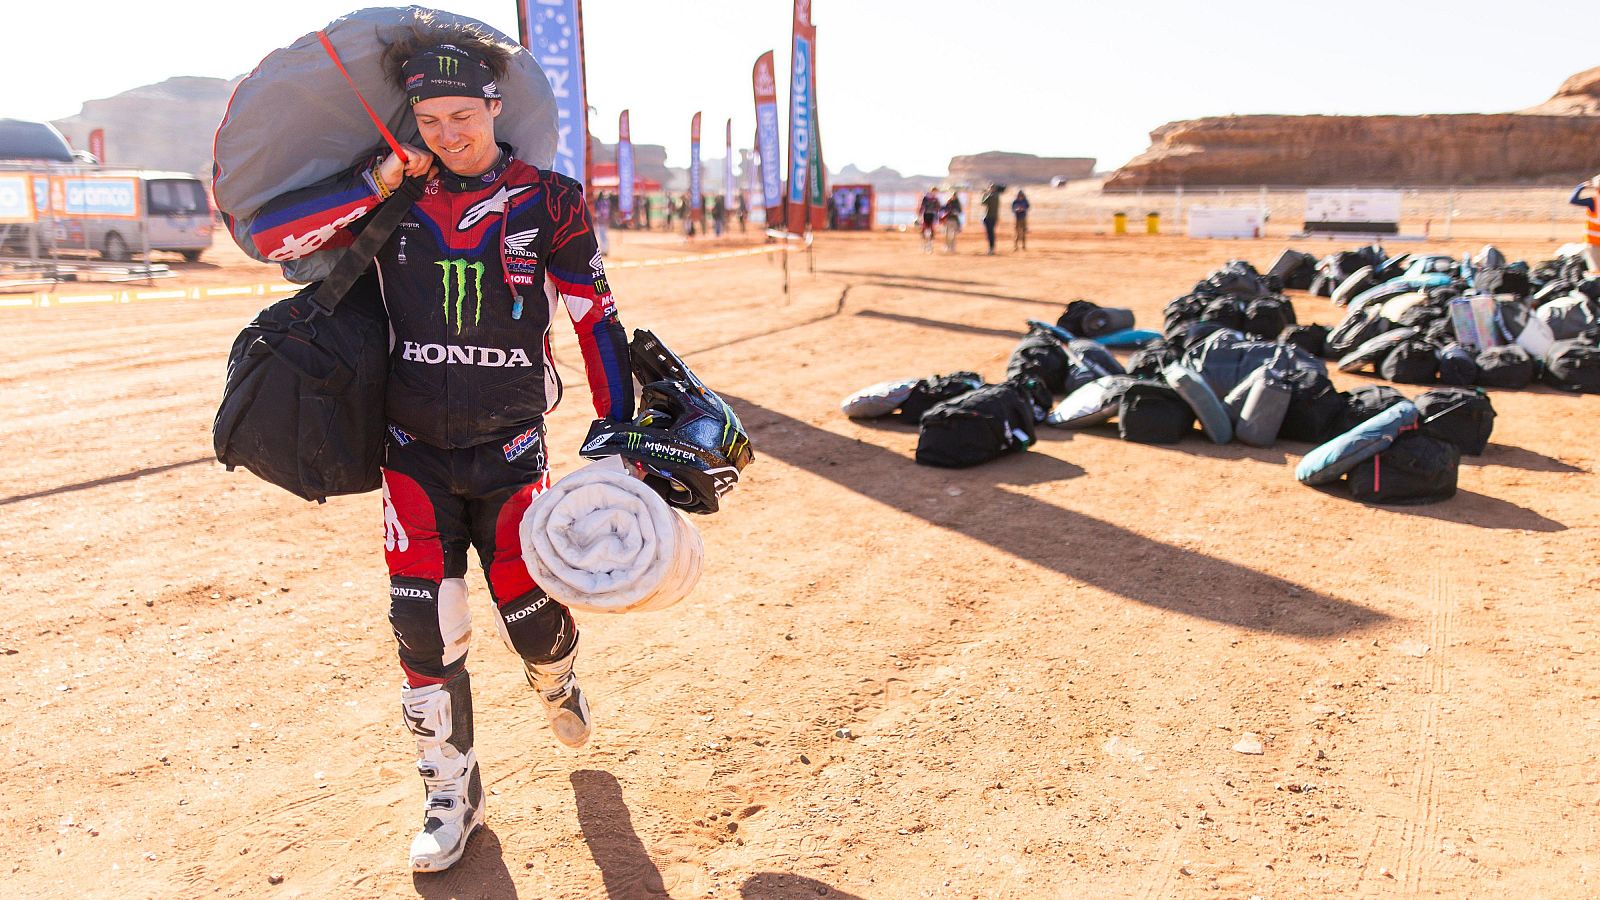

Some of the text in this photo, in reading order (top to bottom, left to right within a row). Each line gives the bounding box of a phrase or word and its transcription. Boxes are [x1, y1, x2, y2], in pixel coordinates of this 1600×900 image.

[793, 51, 809, 191] aramco
[504, 248, 538, 259] HONDA
[402, 340, 533, 369] HONDA
[503, 426, 539, 461] HRC
[586, 435, 605, 450] AIROH
[644, 441, 696, 462] MONSTER
[651, 452, 688, 464] ENERGY
